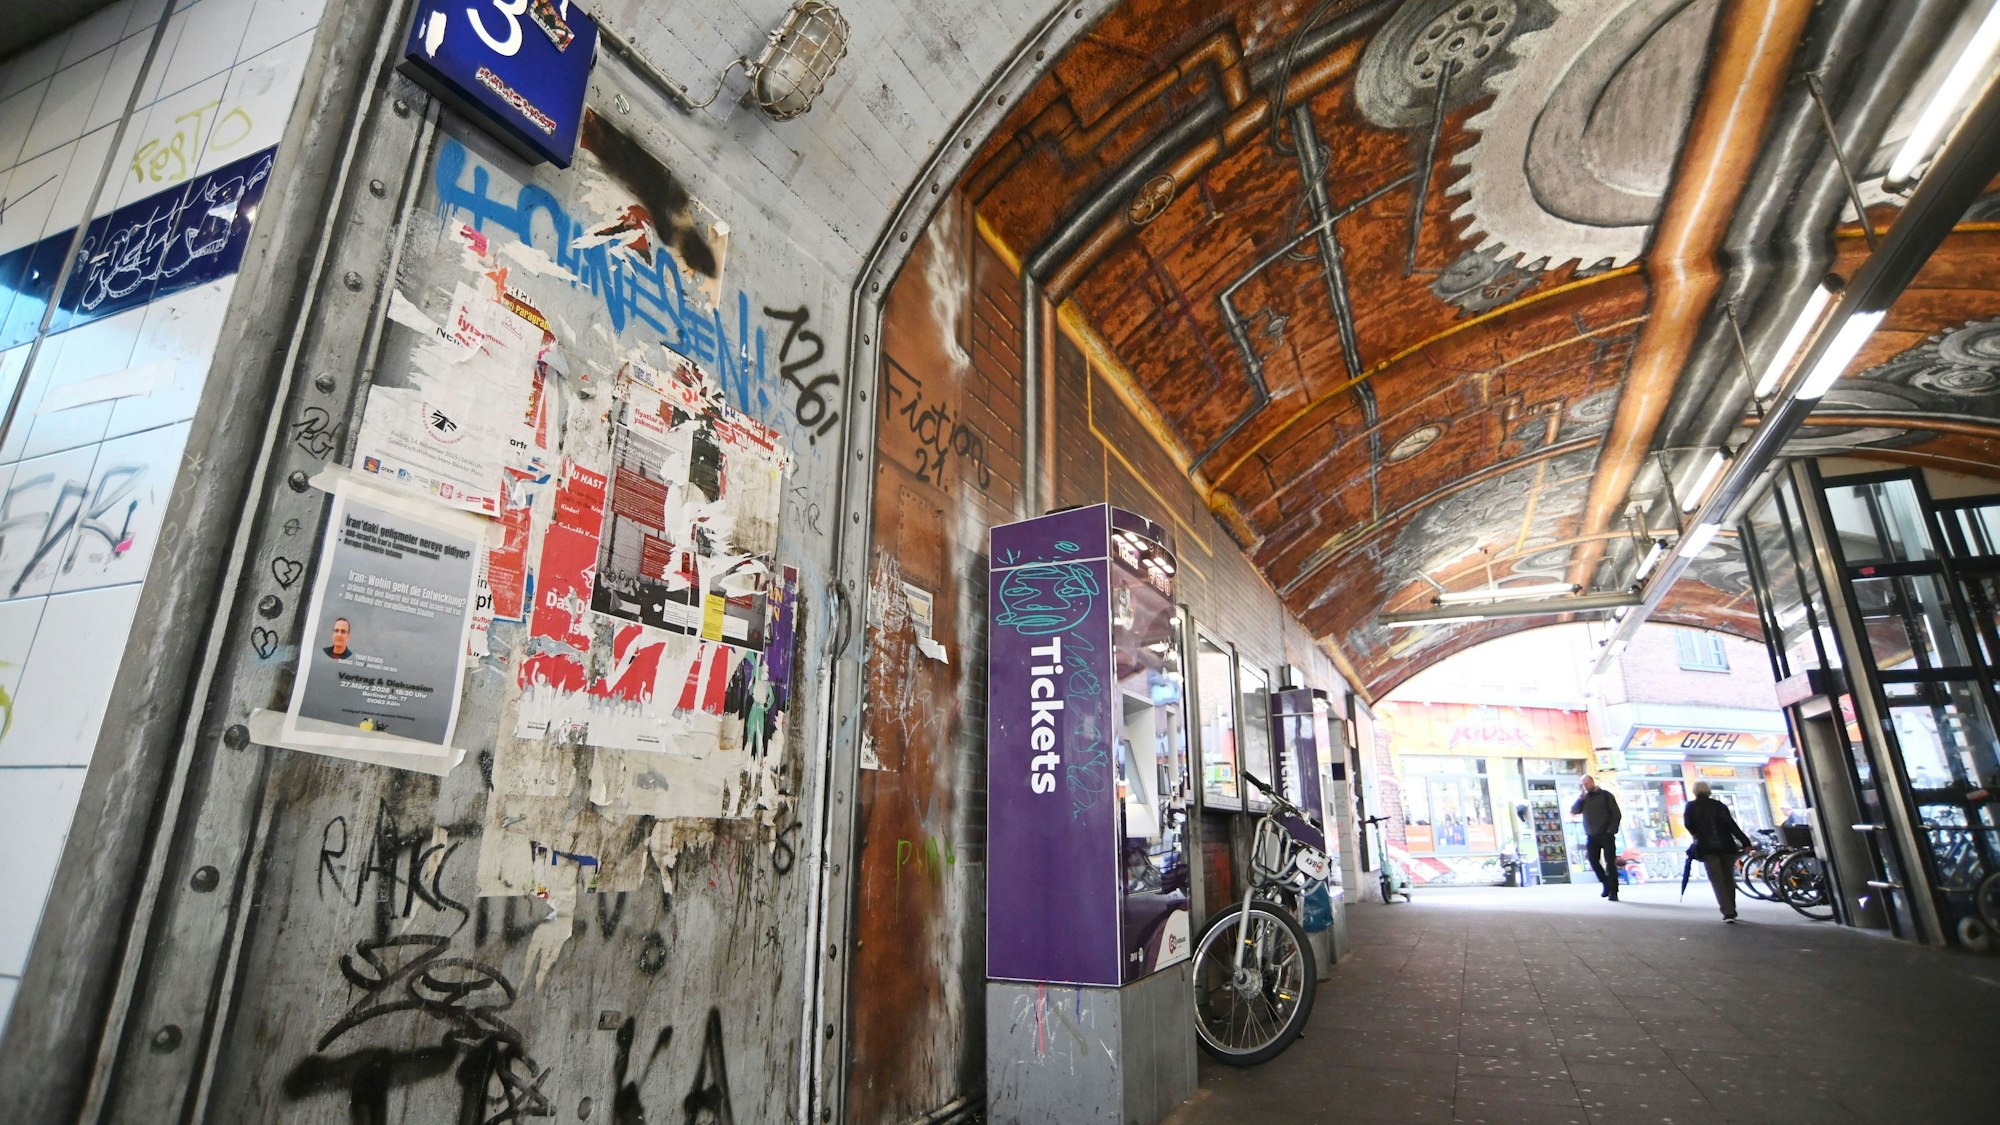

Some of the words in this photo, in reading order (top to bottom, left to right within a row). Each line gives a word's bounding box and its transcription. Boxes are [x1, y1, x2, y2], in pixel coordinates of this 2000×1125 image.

[580, 474, 604, 490] HAST
[419, 538, 443, 554] nereye
[349, 570, 367, 584] Iran:
[368, 574, 392, 590] Wohin
[392, 581, 409, 594] geht
[410, 585, 421, 597] die
[422, 587, 467, 608] Entwicklung?
[338, 672, 375, 686] Vortrag
[377, 678, 384, 686] &
[386, 679, 434, 693] Diskussion
[362, 690, 388, 700] Berliner
[371, 685, 390, 694] 2026
[414, 690, 428, 699] Uhr
[386, 699, 401, 707] Köln
[1031, 636, 1065, 795] Tickets
[1680, 731, 1740, 750] GIZEH
[1280, 747, 1297, 818] Tickes
[1304, 856, 1317, 868] KVB
